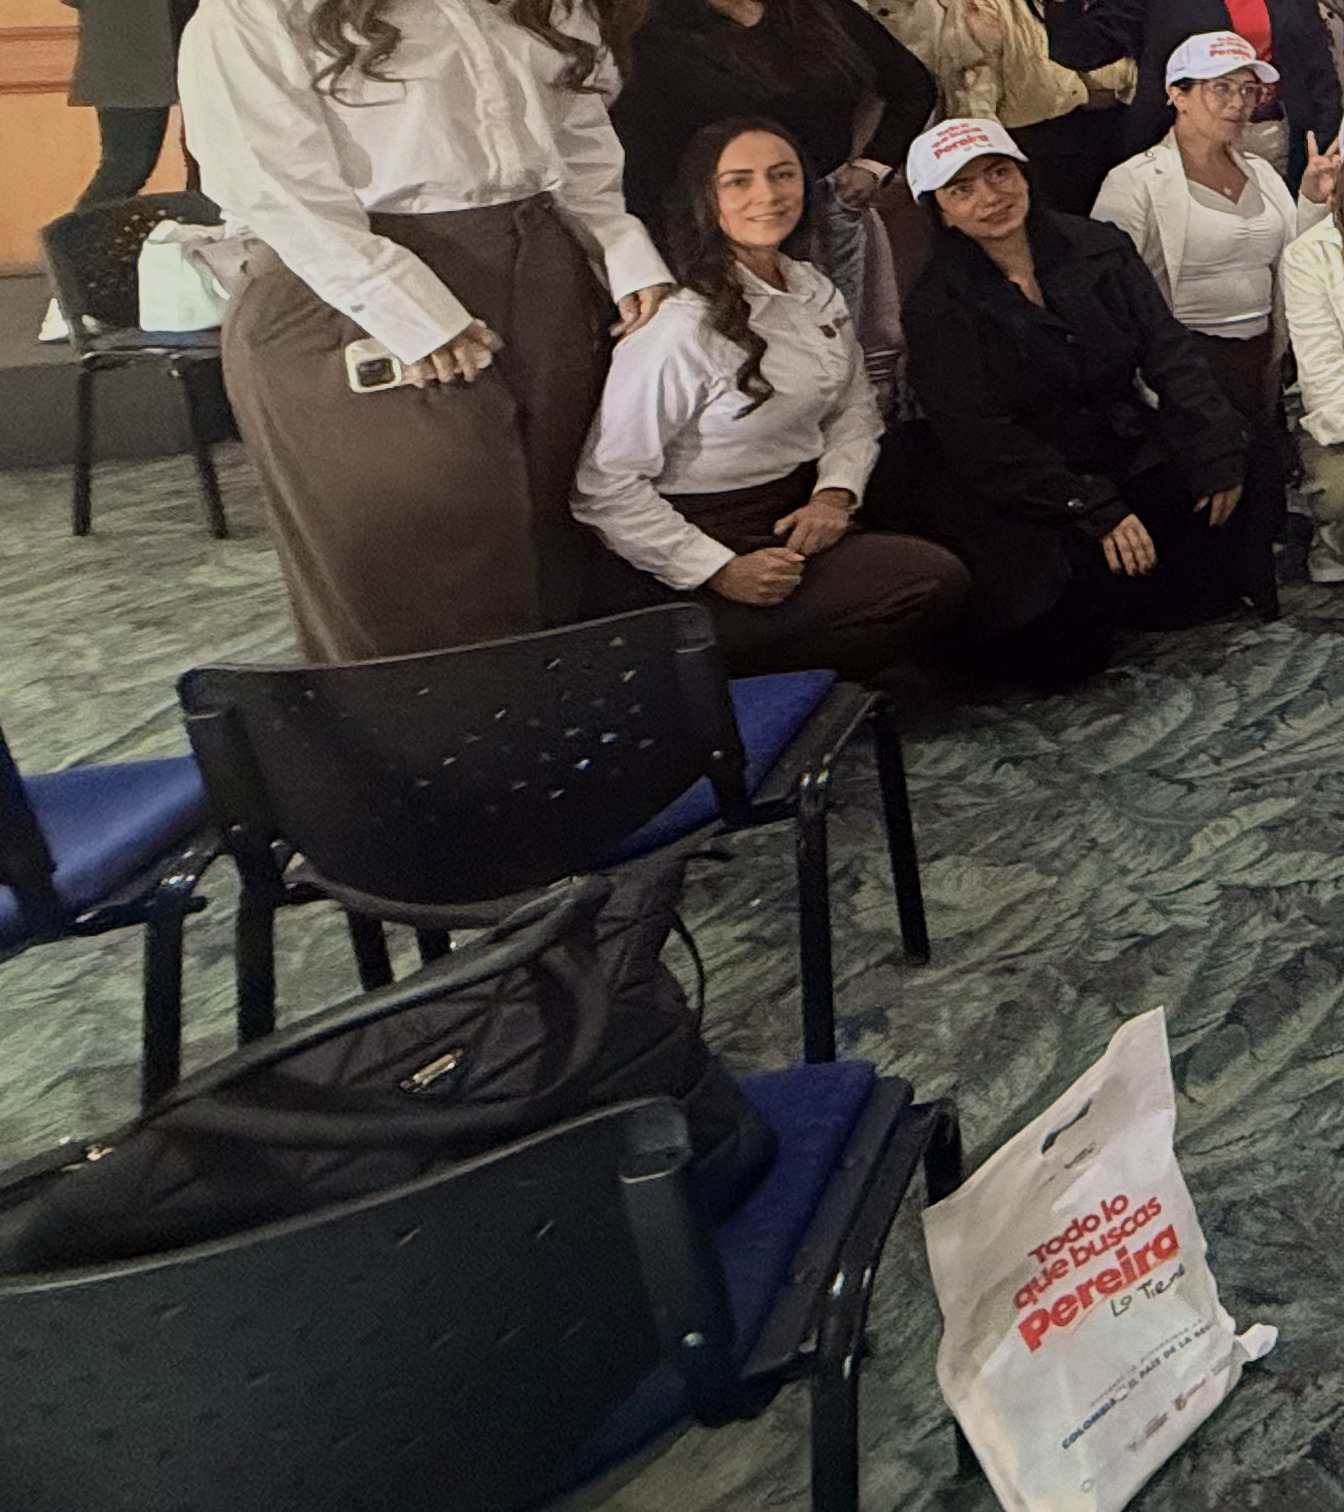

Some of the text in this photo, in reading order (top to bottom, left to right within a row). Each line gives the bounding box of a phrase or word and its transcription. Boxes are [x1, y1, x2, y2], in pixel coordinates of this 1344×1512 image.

[1012, 1196, 1162, 1309] que buscas
[1028, 1194, 1128, 1263] Todo lo
